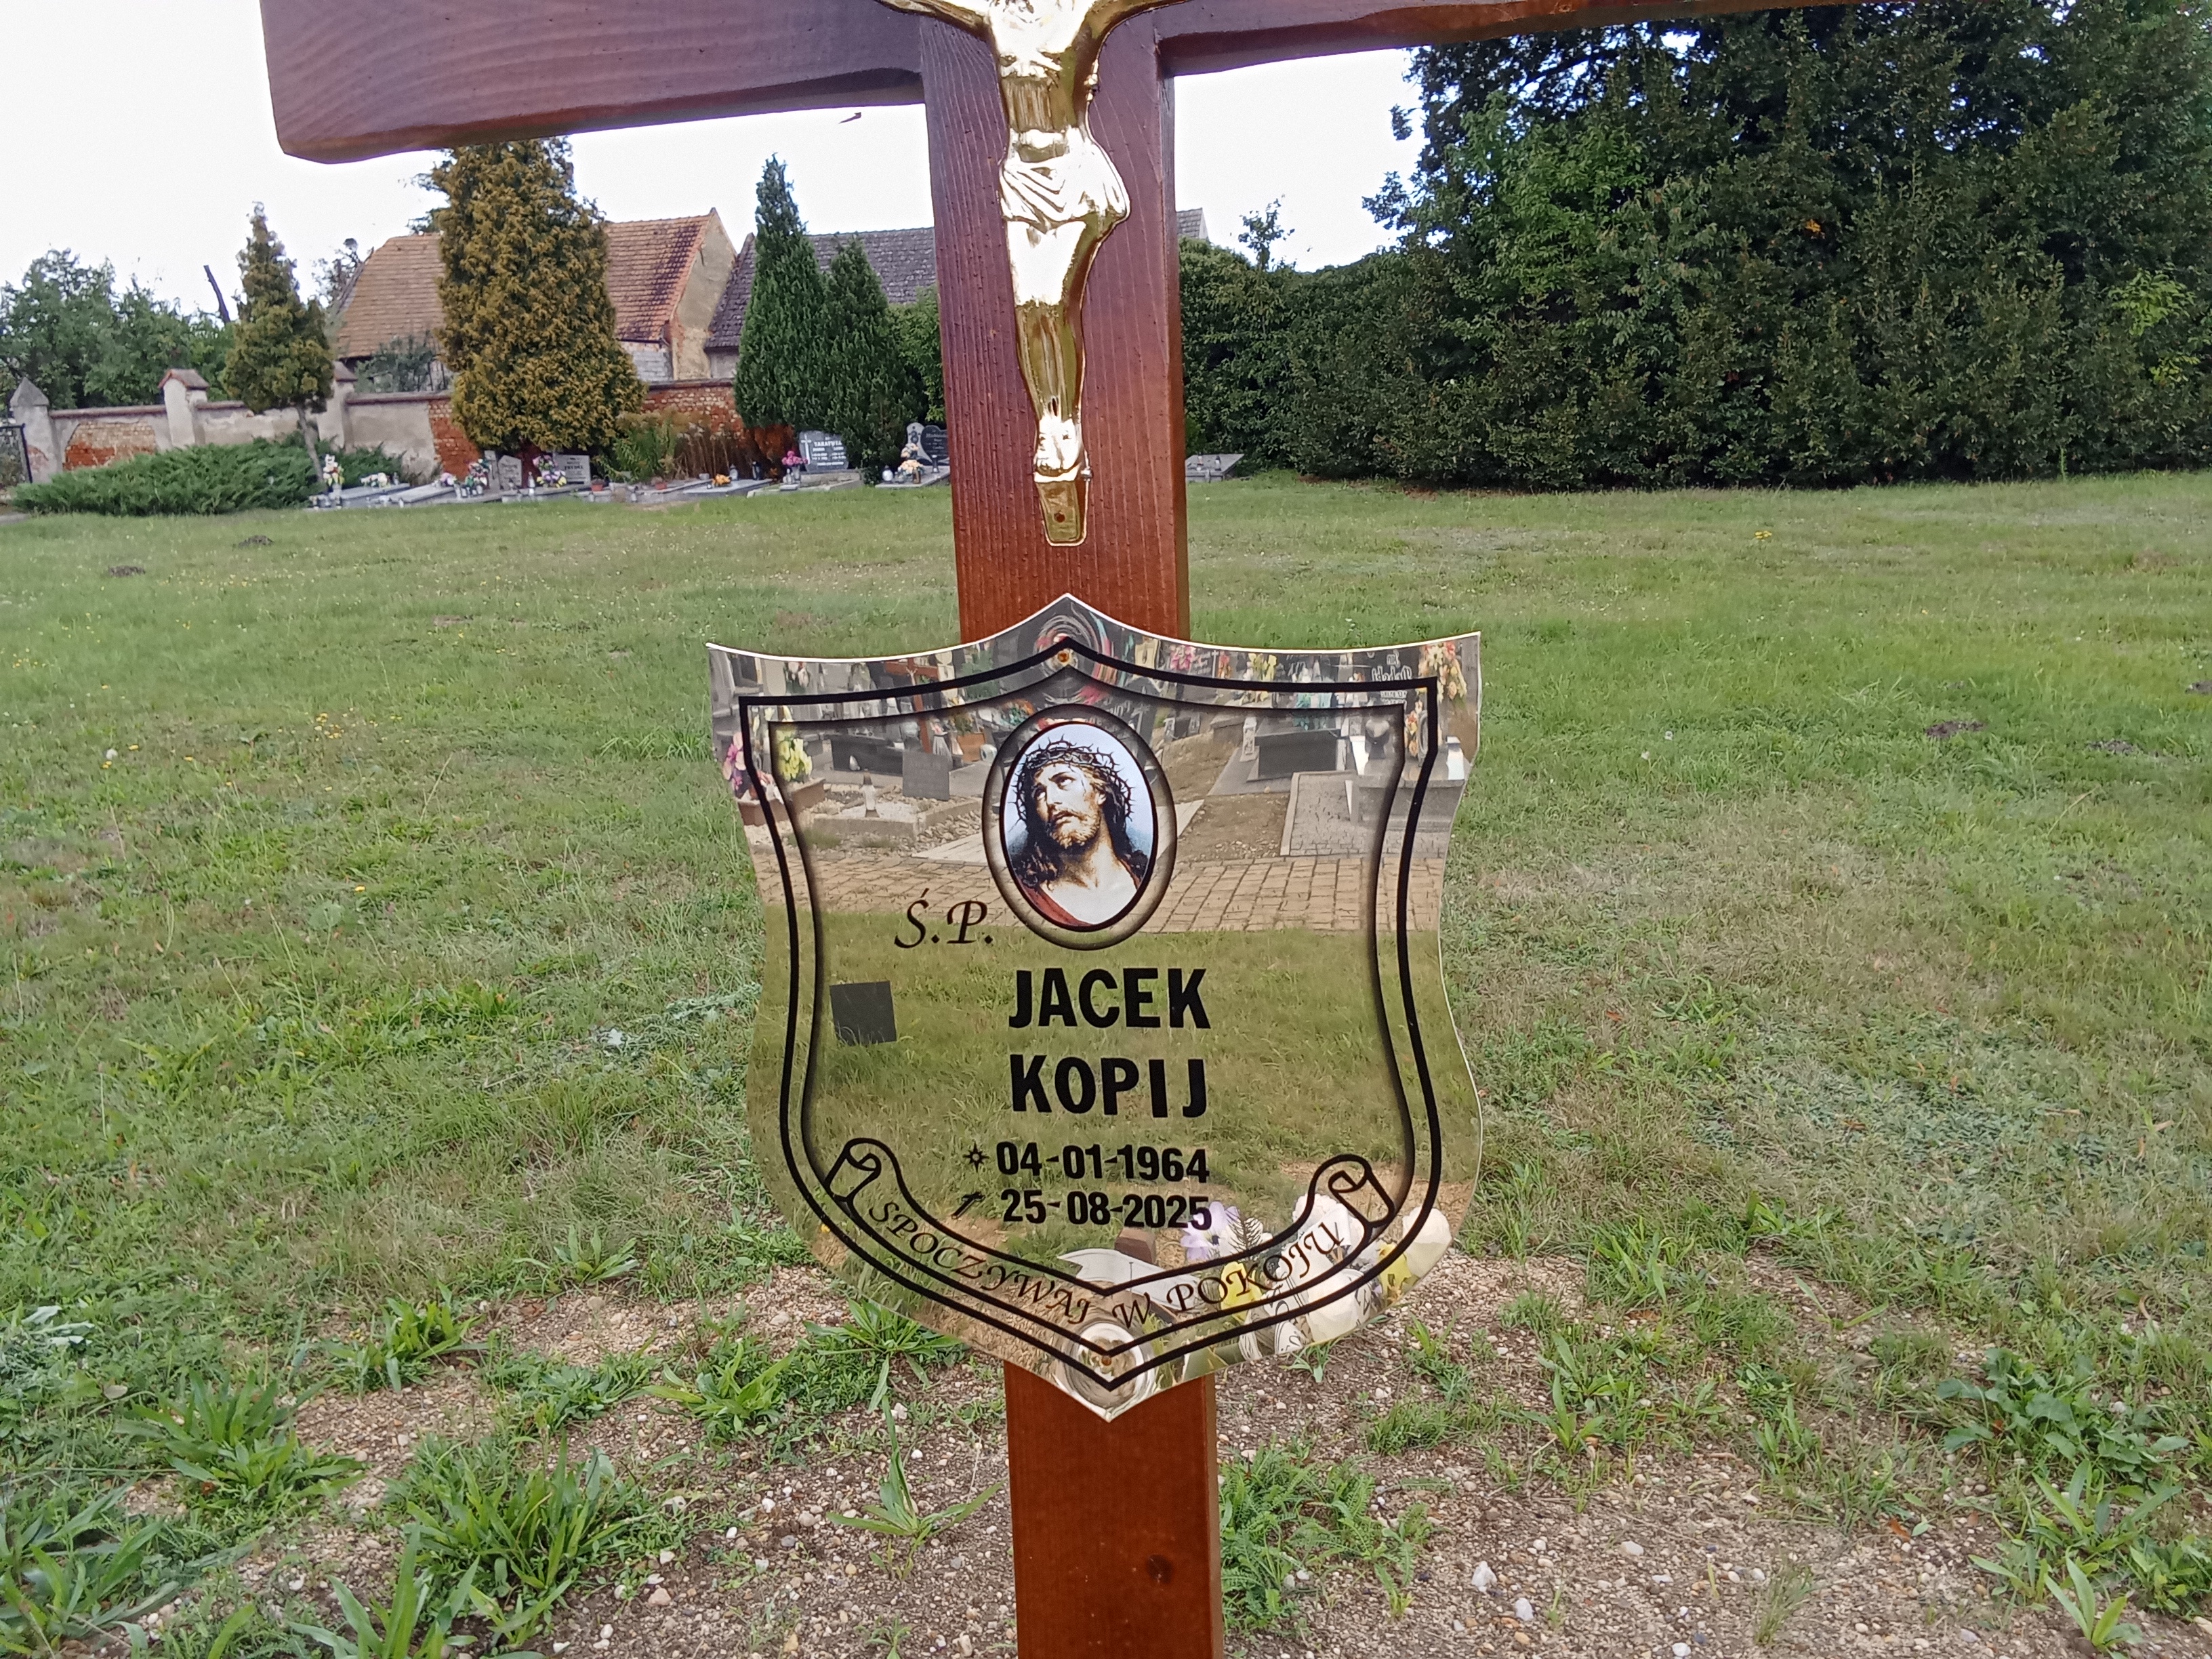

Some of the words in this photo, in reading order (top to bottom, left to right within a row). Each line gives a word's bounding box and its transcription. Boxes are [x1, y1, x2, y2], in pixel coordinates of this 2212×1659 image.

[894, 888, 994, 949] Ś.P.
[1008, 968, 1211, 1029] JACEK
[1009, 1054, 1208, 1118] KOPIJ
[996, 1142, 1210, 1183] 04-01-1964
[1000, 1189, 1212, 1231] 25-08-2025
[869, 1202, 1090, 1324] SPOCZYWAJ
[1112, 1292, 1151, 1328] W
[1166, 1221, 1345, 1312] POKOJU
